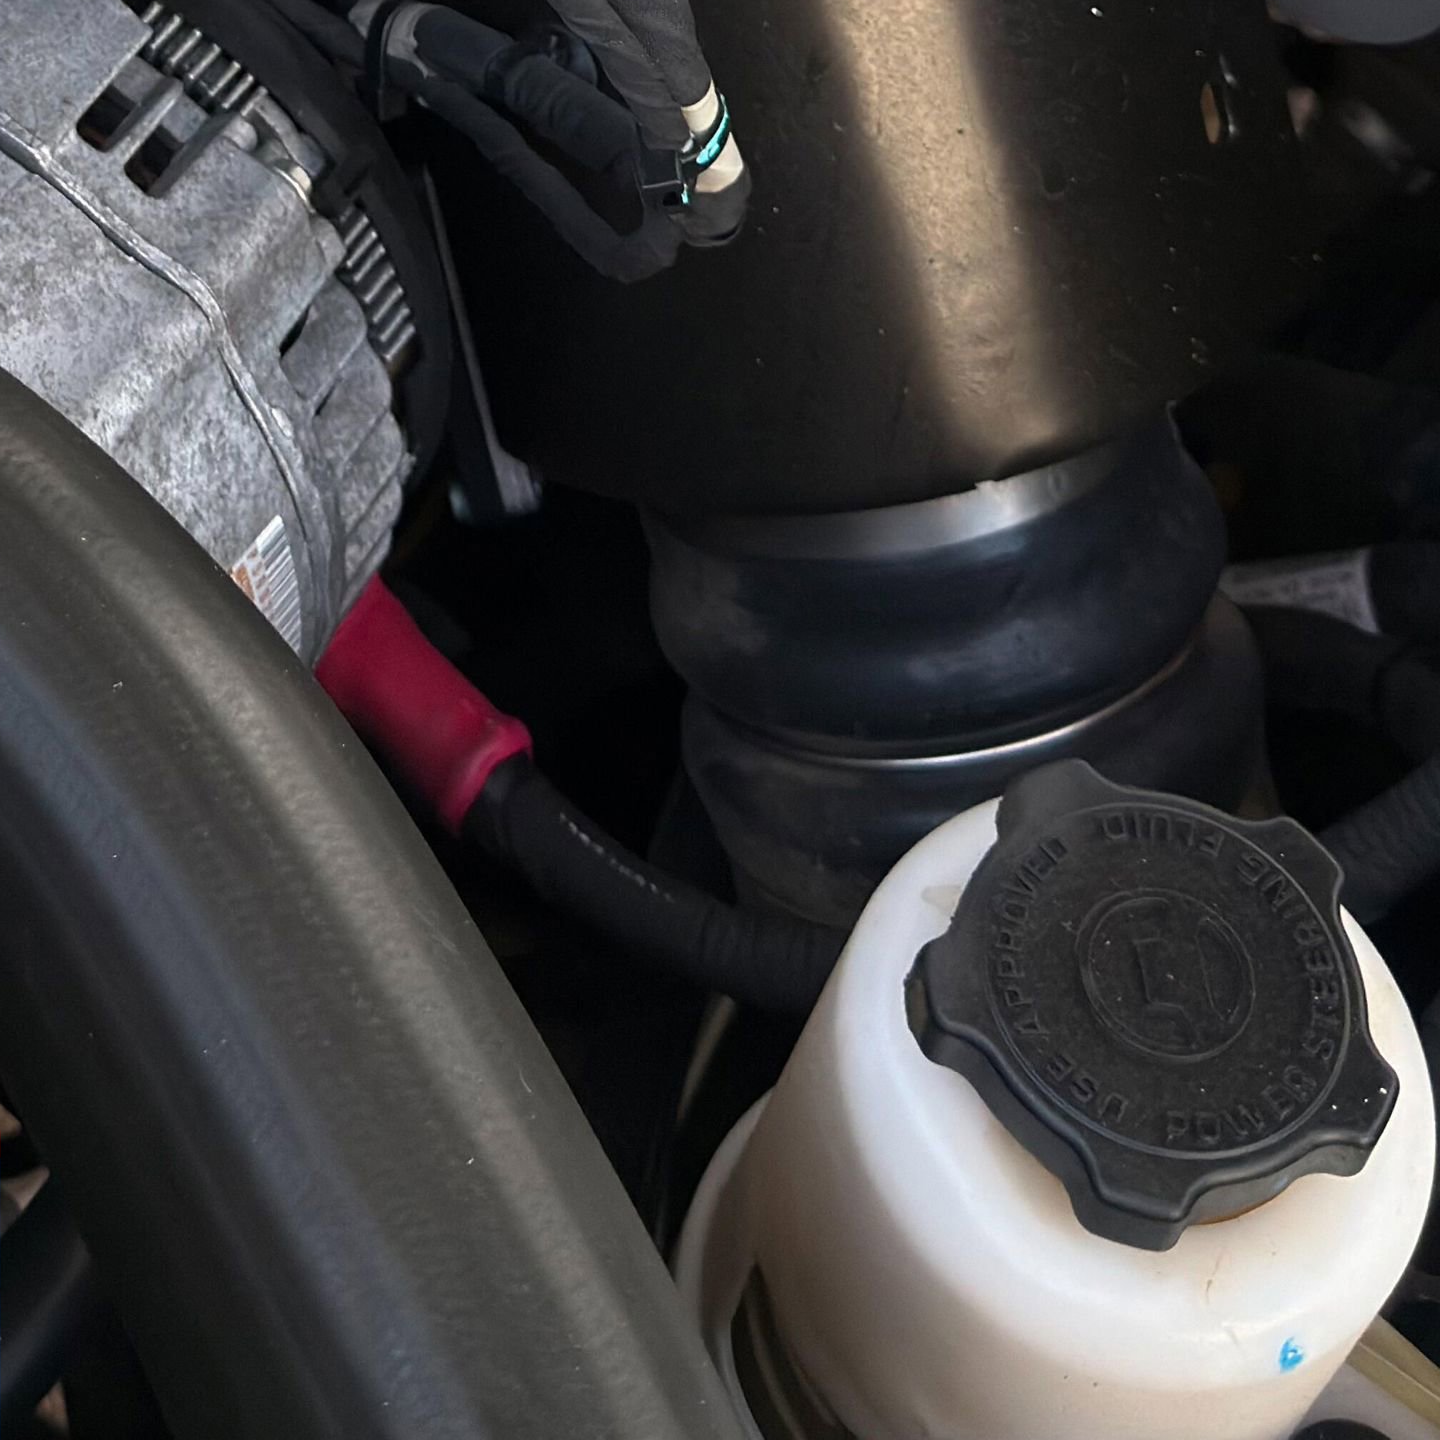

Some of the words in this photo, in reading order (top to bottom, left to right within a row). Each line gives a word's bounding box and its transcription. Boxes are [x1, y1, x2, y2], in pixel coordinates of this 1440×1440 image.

[1100, 812, 1225, 858] FLUID
[993, 836, 1069, 1040] APPROVED
[1235, 849, 1340, 1062] STEERING
[1045, 1054, 1129, 1125] USE
[1166, 1063, 1319, 1145] POWER
